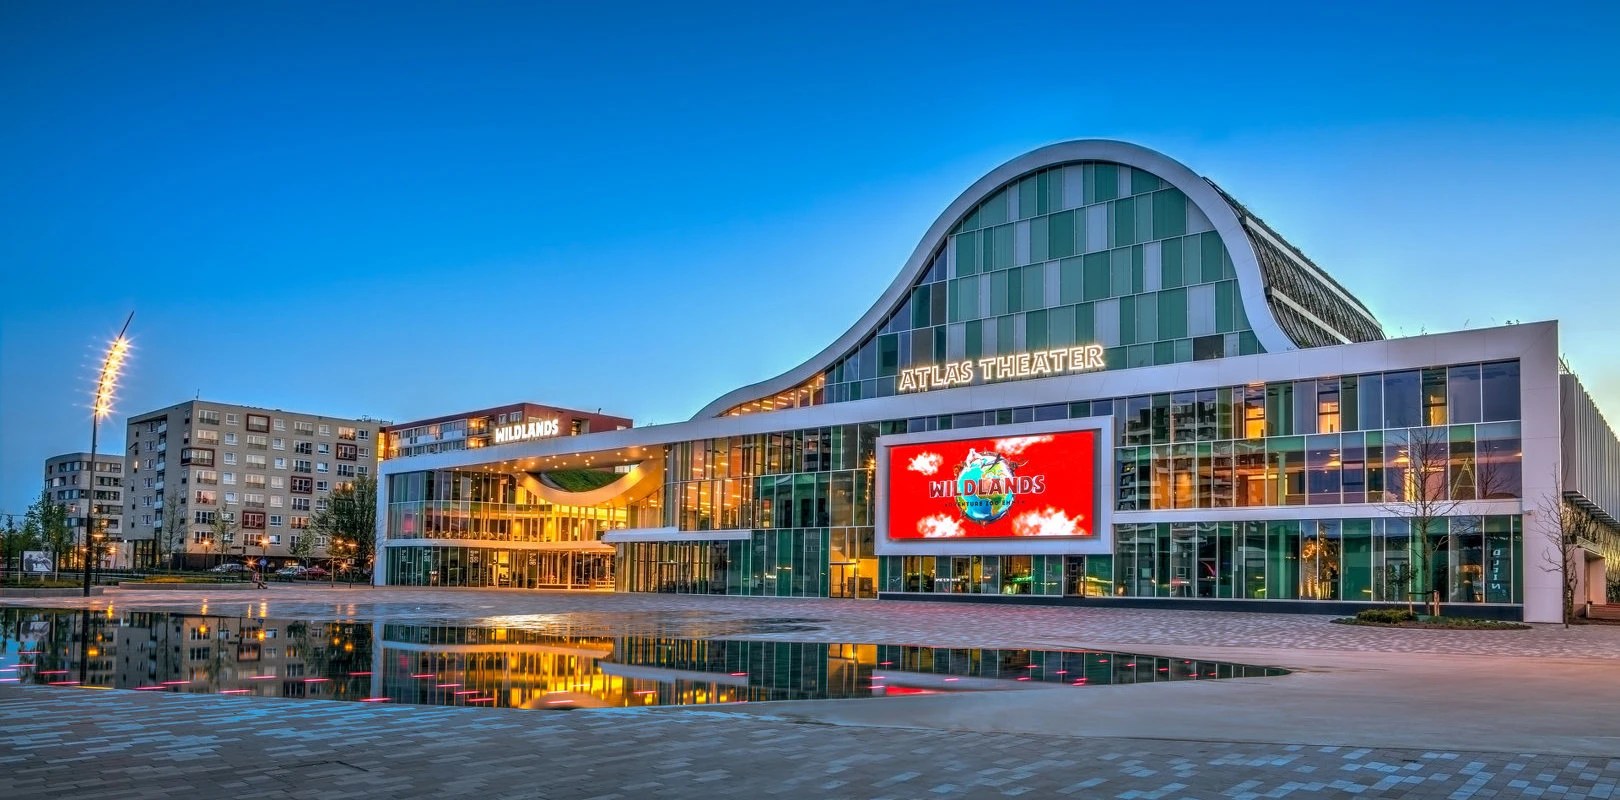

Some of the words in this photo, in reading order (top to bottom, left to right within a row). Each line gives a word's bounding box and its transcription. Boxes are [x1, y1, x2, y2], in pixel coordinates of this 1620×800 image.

[899, 361, 973, 391] ATLAS
[979, 345, 1105, 380] THEATER
[495, 418, 559, 442] WILDLANDS
[929, 475, 1046, 498] WILDLANDS
